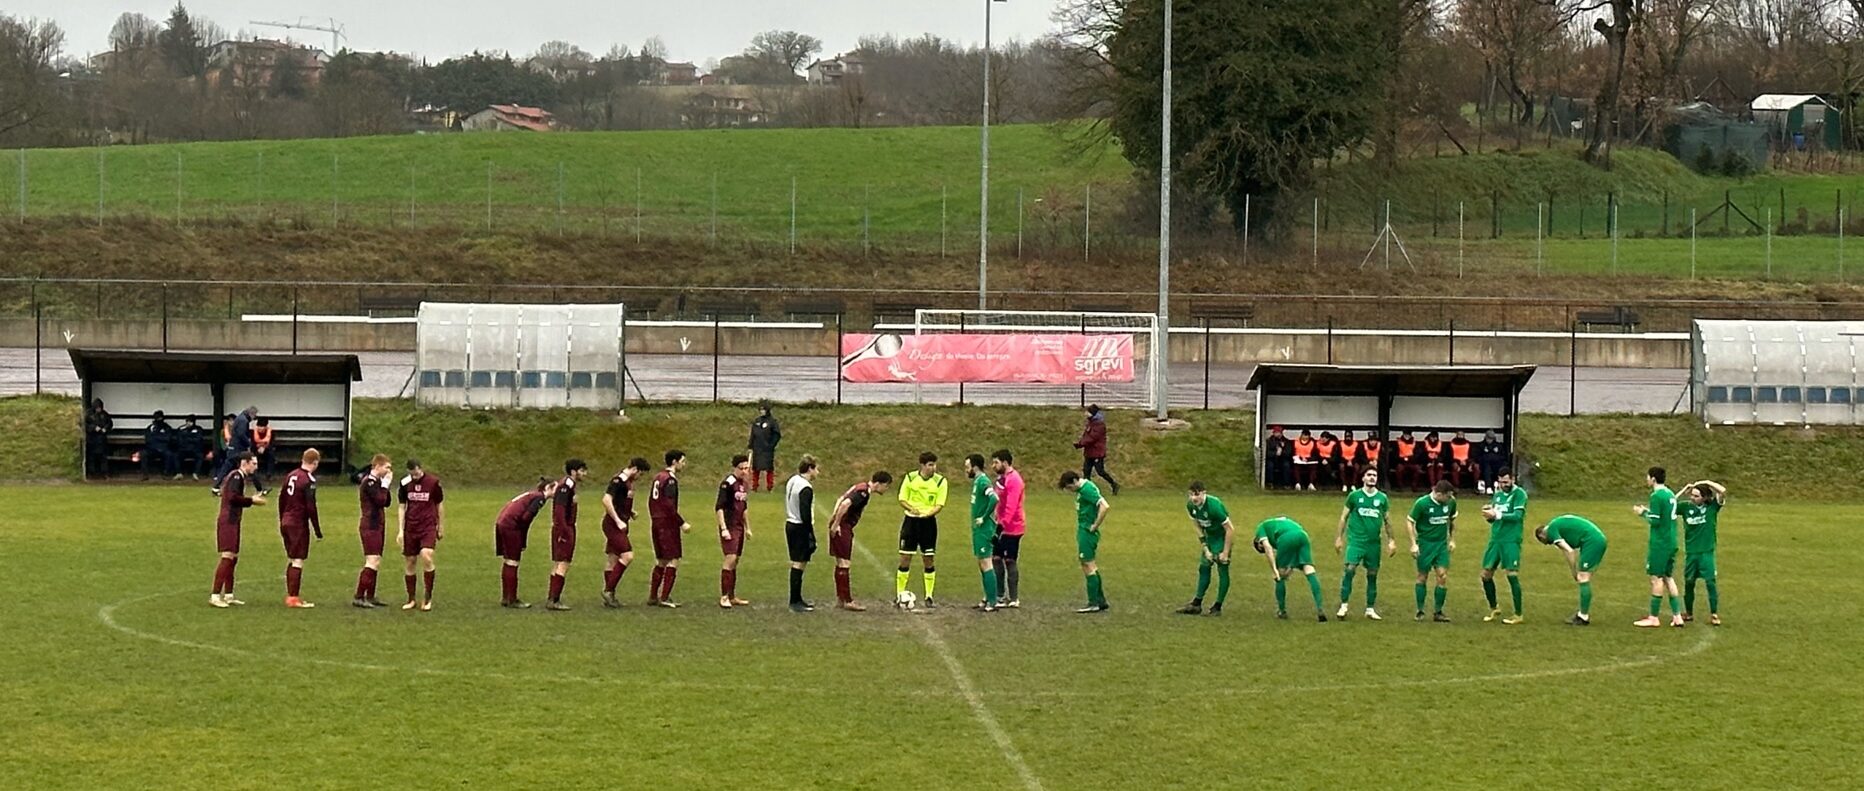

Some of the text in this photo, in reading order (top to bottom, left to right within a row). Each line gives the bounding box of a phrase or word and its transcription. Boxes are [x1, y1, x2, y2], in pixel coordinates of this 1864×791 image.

[1074, 357, 1124, 374] sgrevi
[286, 475, 298, 496] 5
[652, 479, 660, 500] 6
[1669, 497, 1678, 520] 2
